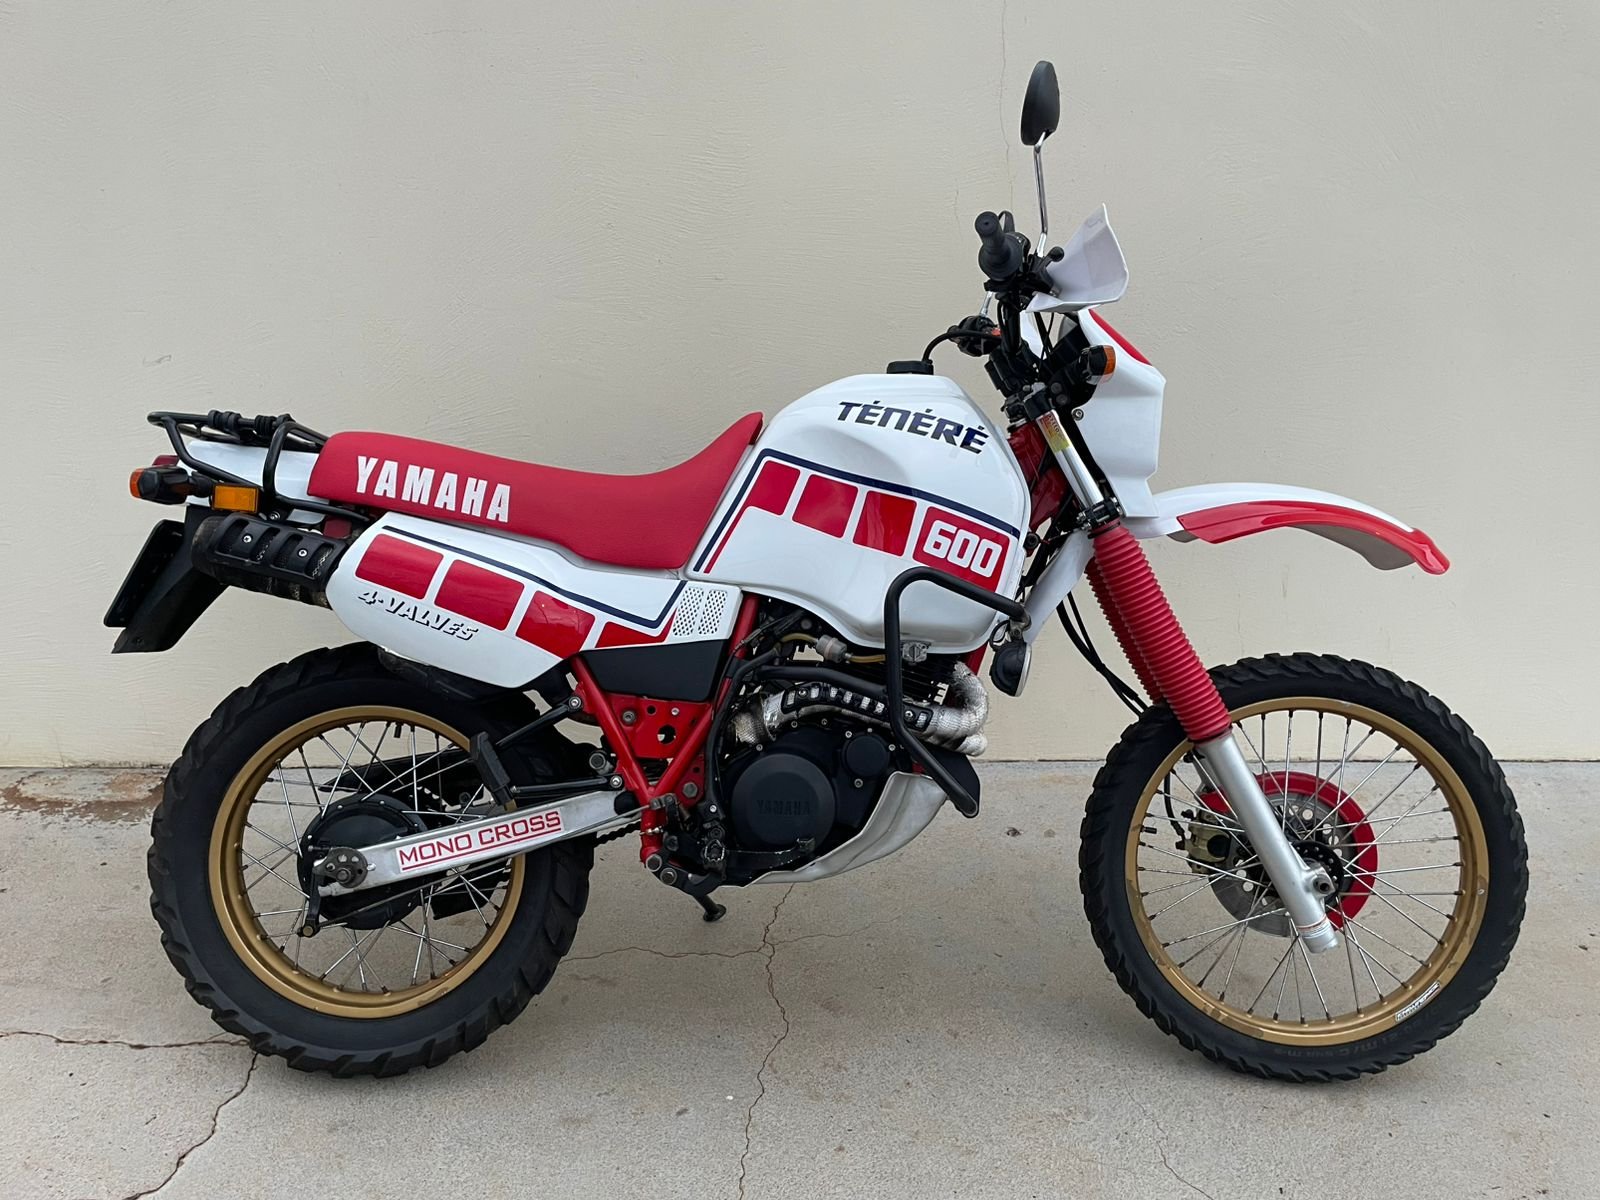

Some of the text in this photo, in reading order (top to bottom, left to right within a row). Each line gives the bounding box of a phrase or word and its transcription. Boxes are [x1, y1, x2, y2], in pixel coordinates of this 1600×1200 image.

[356, 455, 511, 523] YAMAHA
[922, 519, 1003, 578] 600
[357, 591, 479, 641] 4-VALVES
[756, 799, 811, 817] YAMAHA
[399, 811, 561, 865] MONO CROSS
